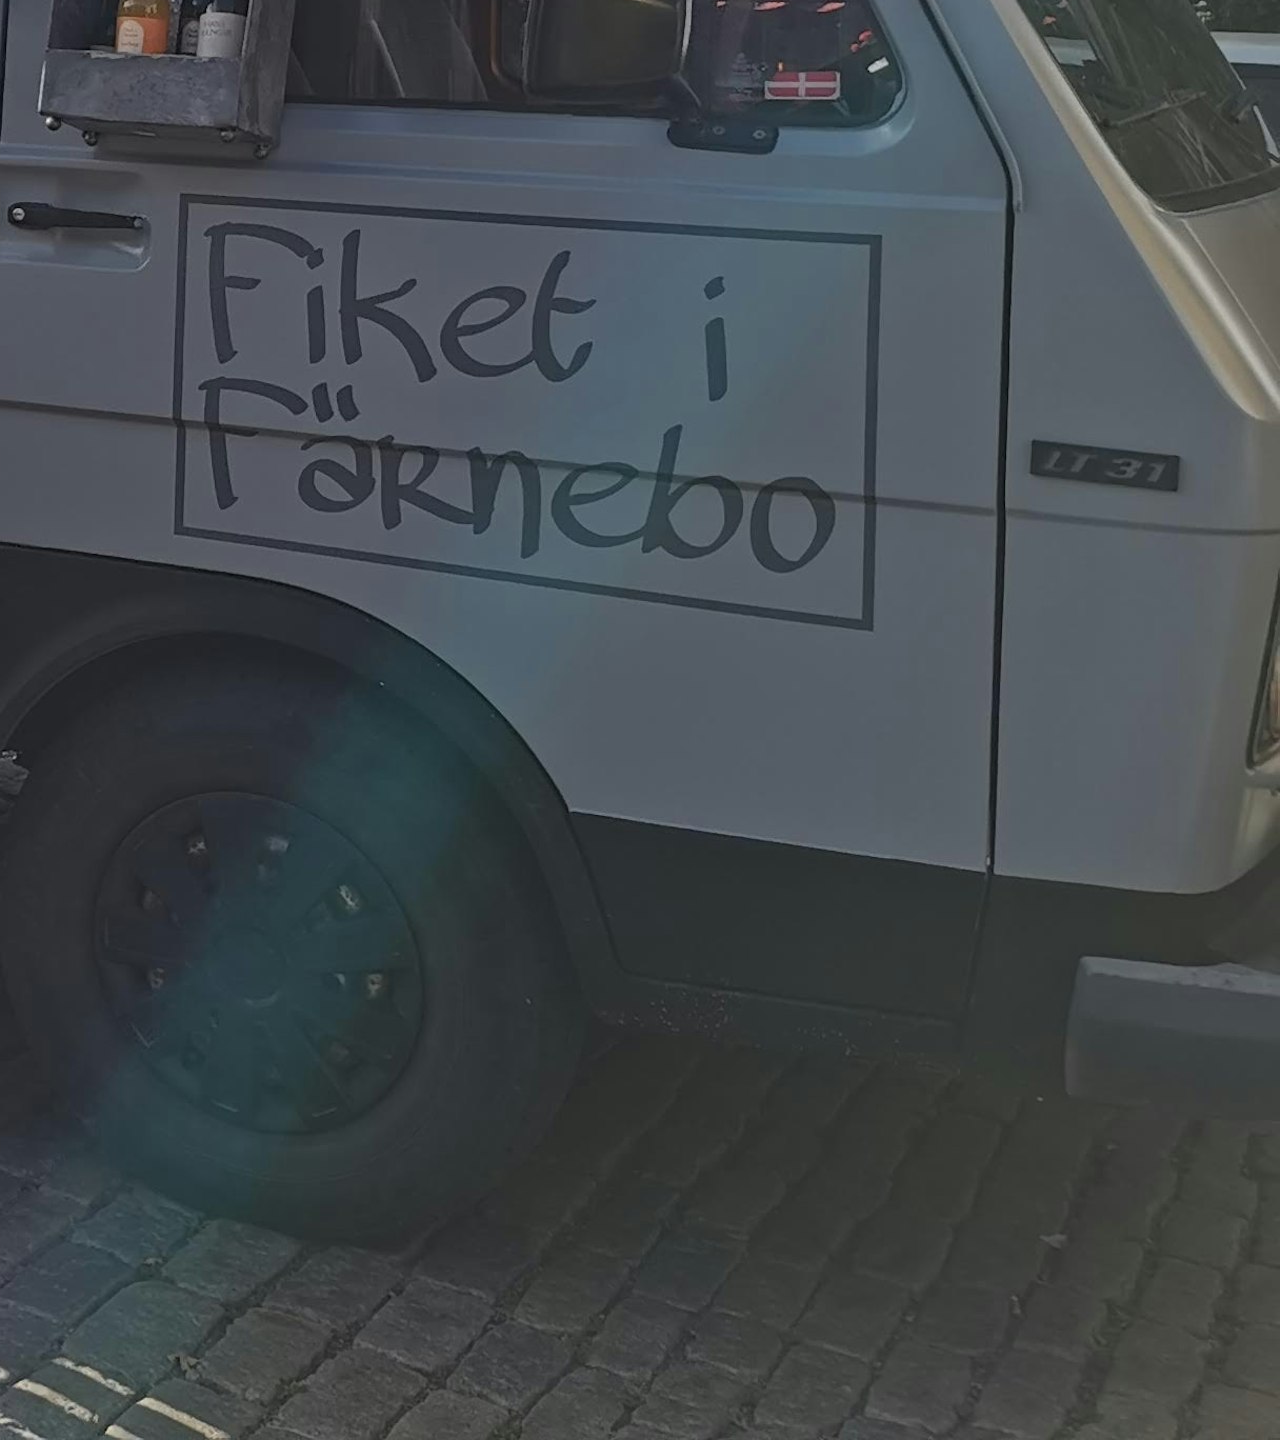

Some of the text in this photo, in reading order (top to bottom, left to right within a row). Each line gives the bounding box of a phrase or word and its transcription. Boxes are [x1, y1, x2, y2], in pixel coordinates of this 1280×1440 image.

[204, 221, 728, 402] Fiket i
[198, 376, 836, 573] Färnebo
[1044, 451, 1166, 483] LT 31
